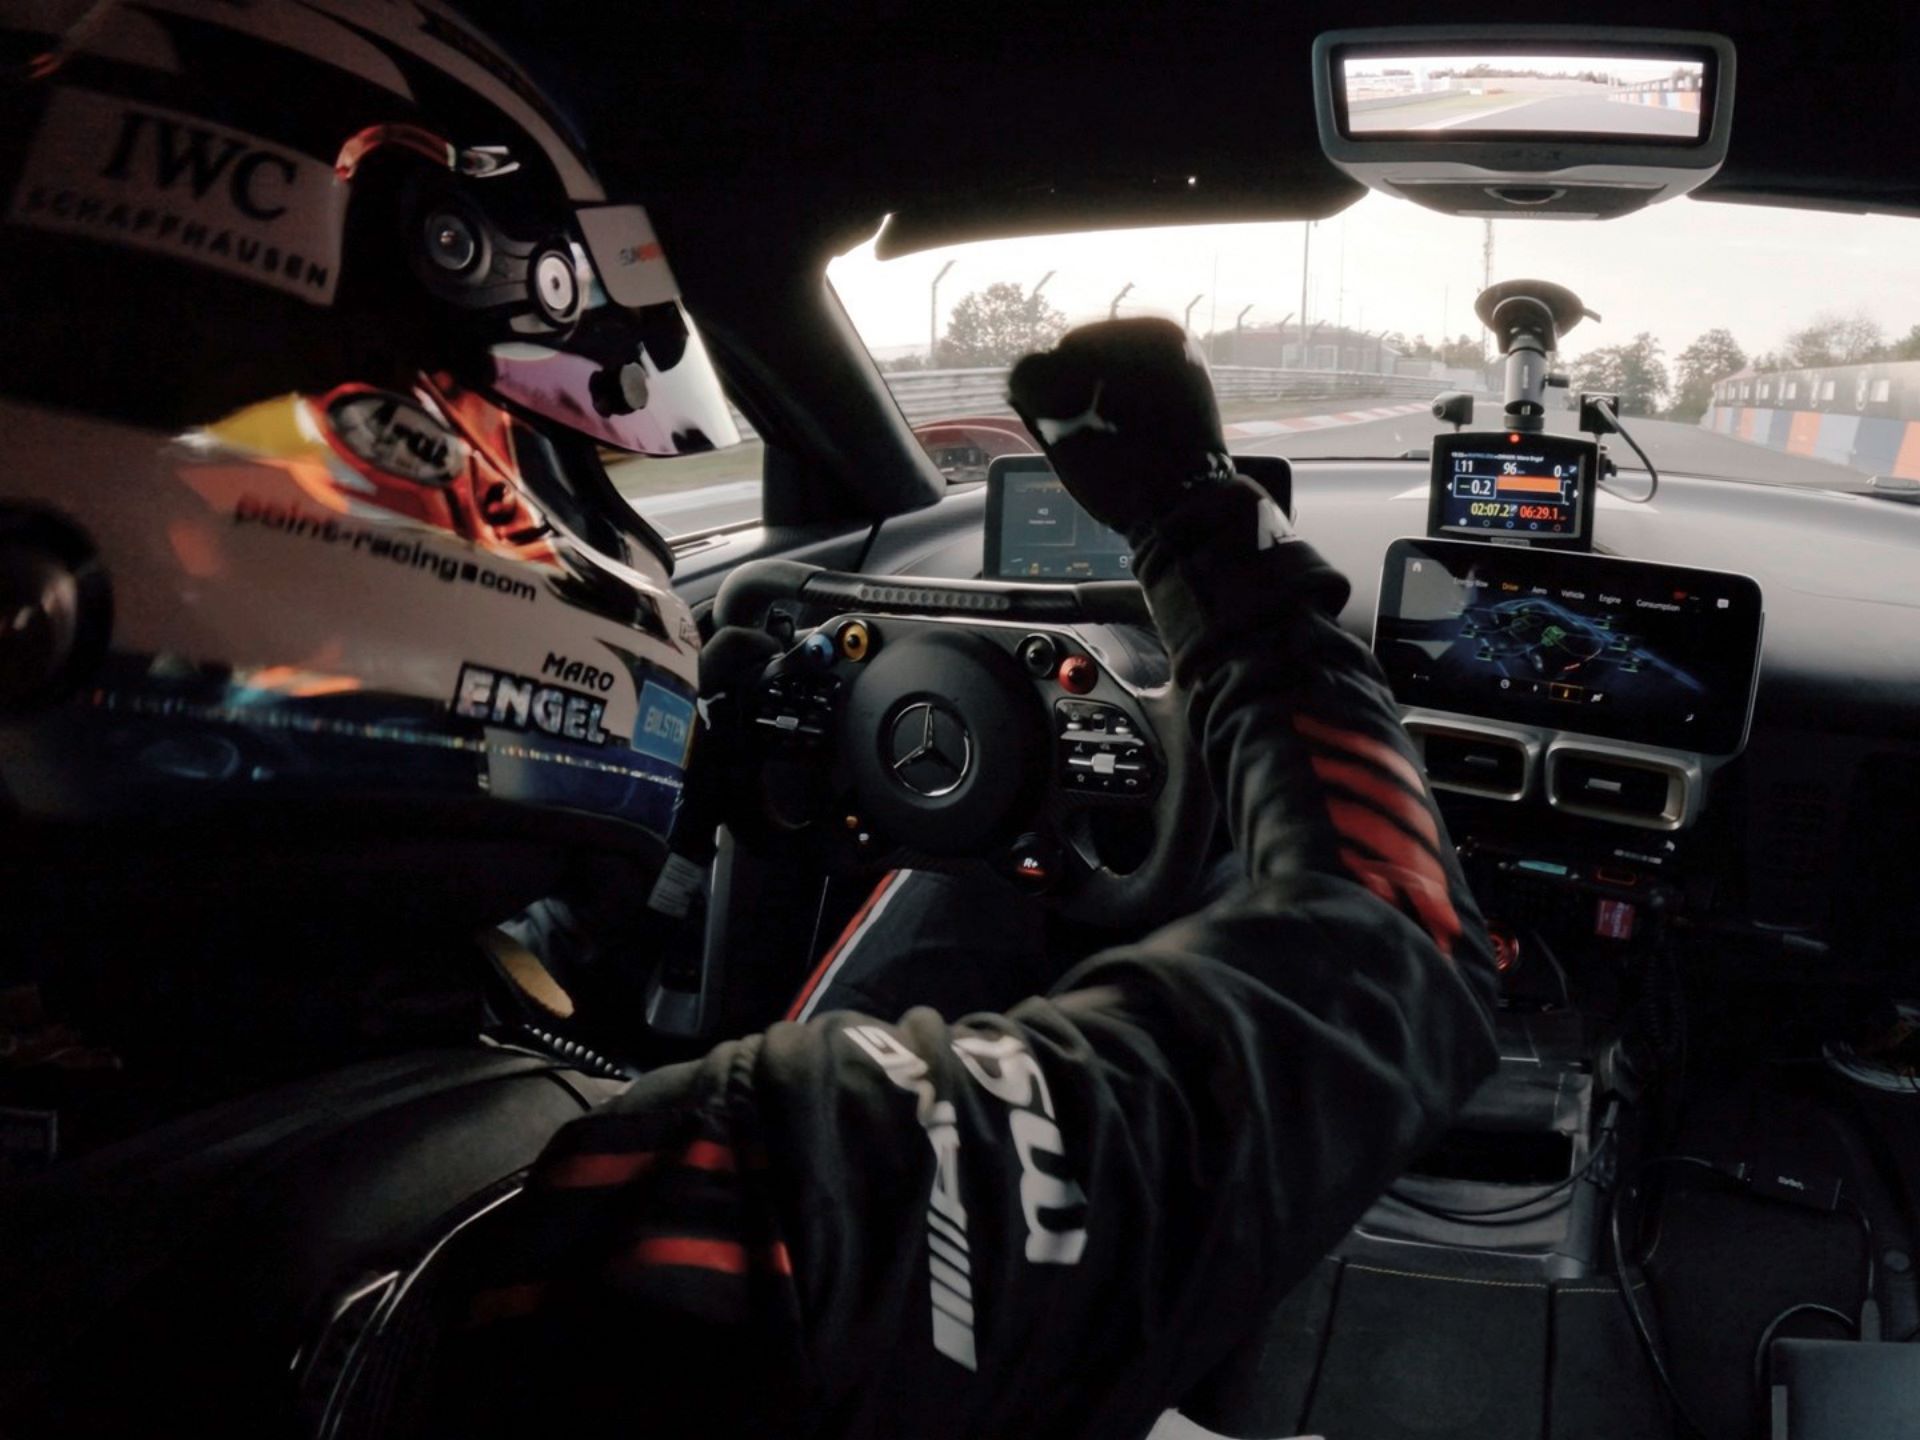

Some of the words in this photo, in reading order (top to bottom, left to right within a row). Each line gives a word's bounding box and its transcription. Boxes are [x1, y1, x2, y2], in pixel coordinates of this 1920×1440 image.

[101, 112, 297, 221] IWC
[27, 187, 327, 289] SCHAFFHAUSEN
[1503, 462, 1517, 475] 96
[1553, 465, 1562, 478] 0
[1561, 589, 1585, 600] Vehicle
[1599, 593, 1622, 605] Engine
[1636, 599, 1681, 612] Consumption
[542, 652, 615, 692] MARO
[453, 663, 610, 746] ENGEL
